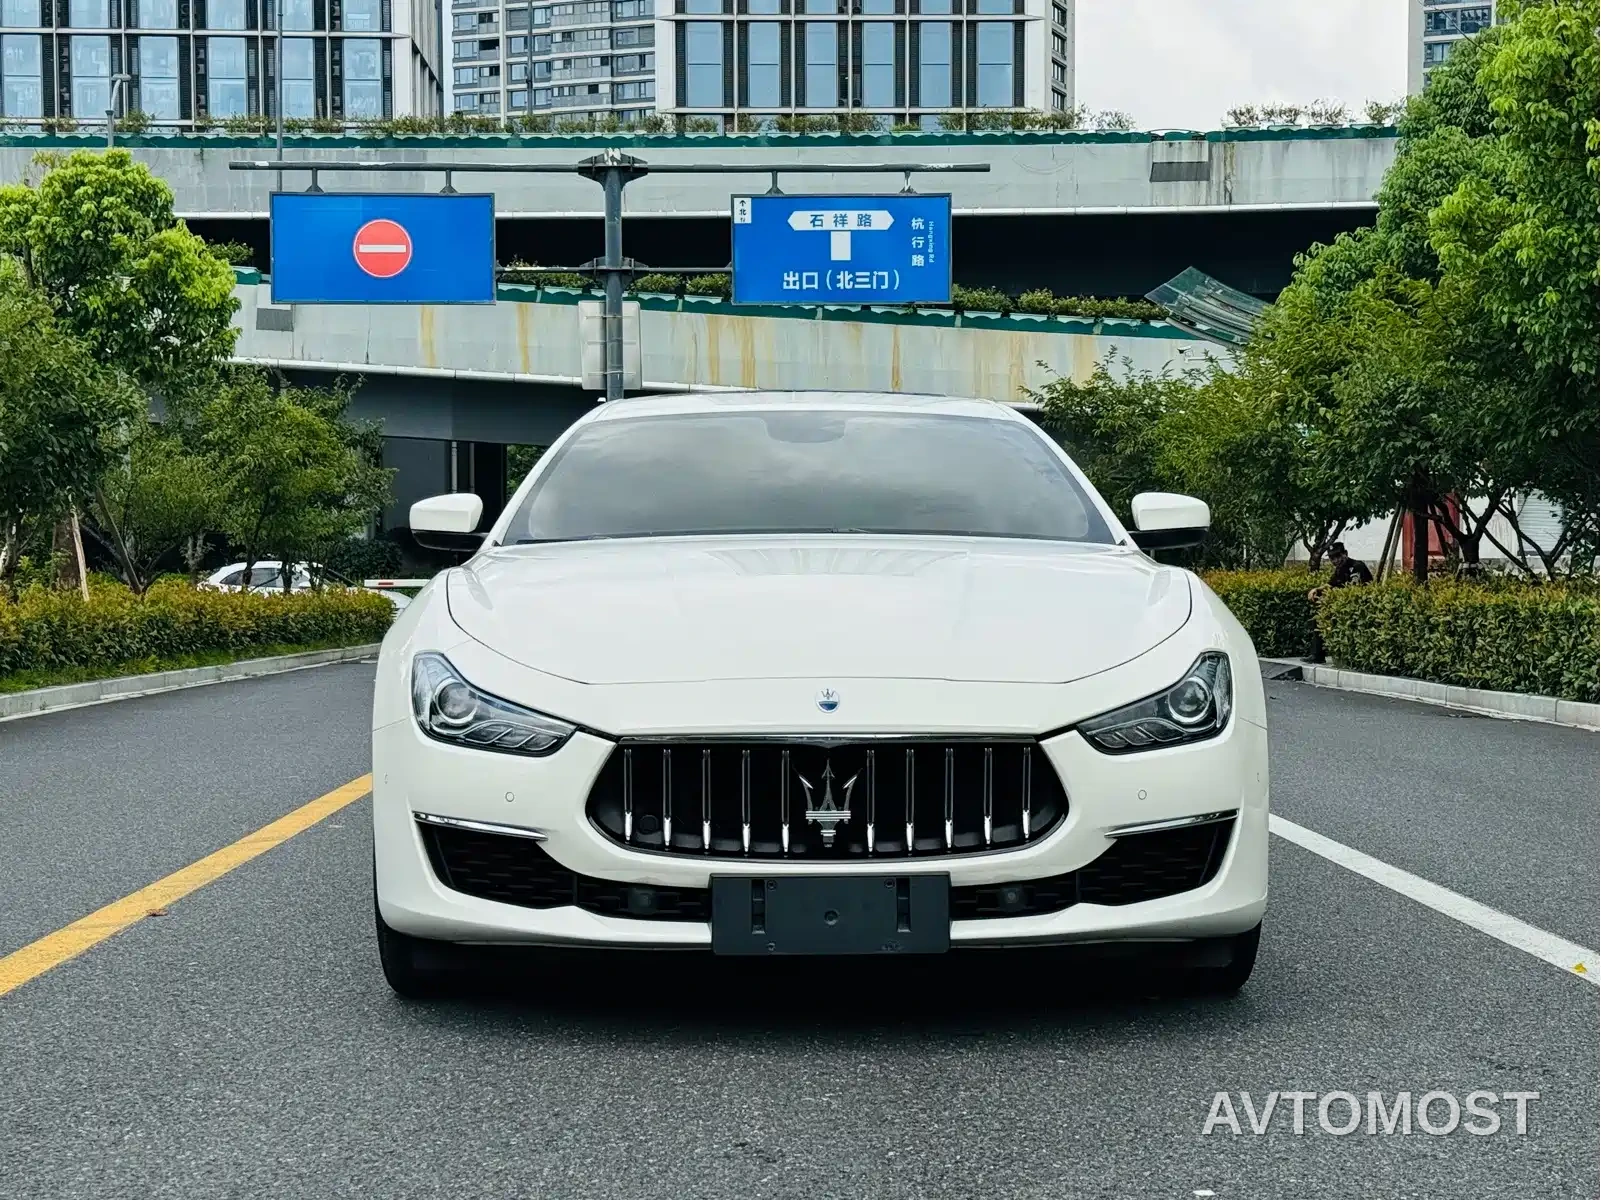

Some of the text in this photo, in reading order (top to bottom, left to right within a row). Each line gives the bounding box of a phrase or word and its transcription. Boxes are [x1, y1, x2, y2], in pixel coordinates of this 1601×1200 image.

[809, 213, 872, 228] 石祥路
[911, 217, 925, 267] 杭行路
[928, 254, 935, 263] Rd
